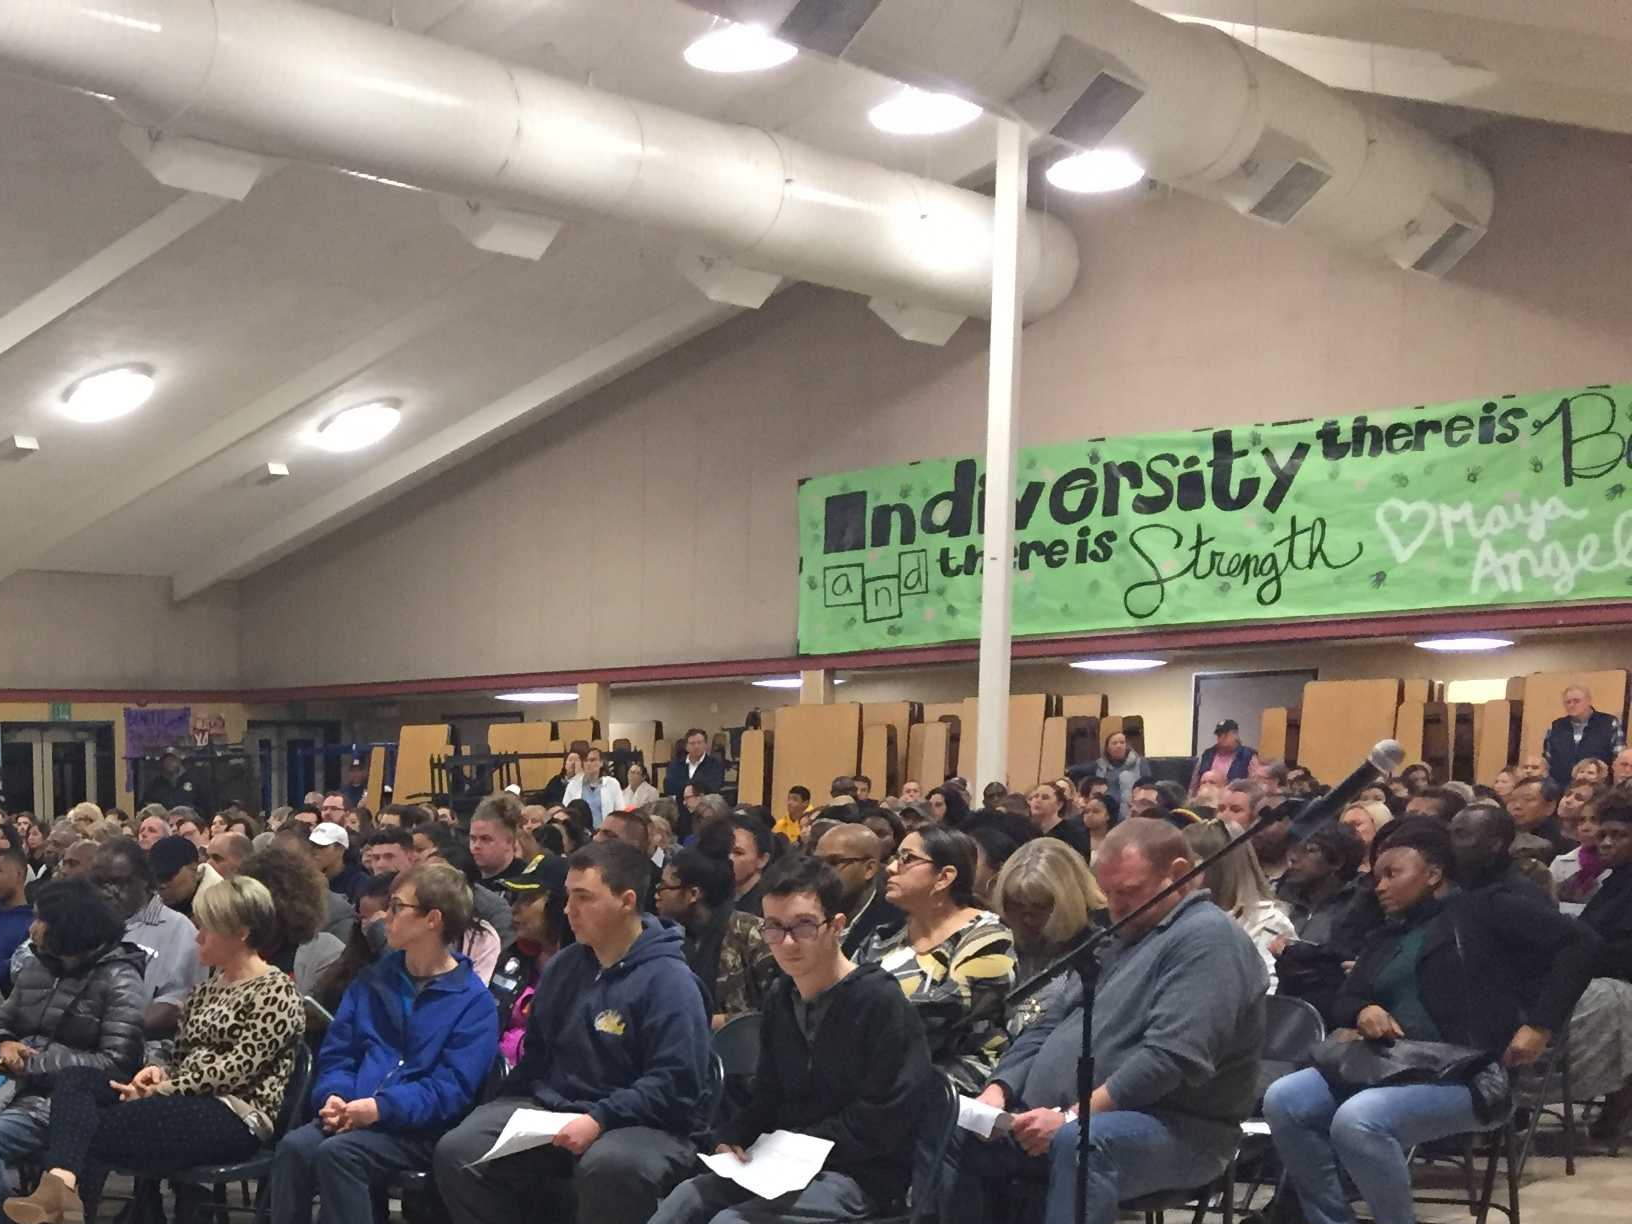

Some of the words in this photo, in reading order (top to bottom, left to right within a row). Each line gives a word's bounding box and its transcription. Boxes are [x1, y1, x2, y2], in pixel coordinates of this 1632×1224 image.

[921, 430, 1311, 538] dversity
[1530, 392, 1632, 487] B
[937, 536, 1067, 577] thre
[1123, 514, 1363, 618] Strength
[1439, 496, 1588, 548] Maya
